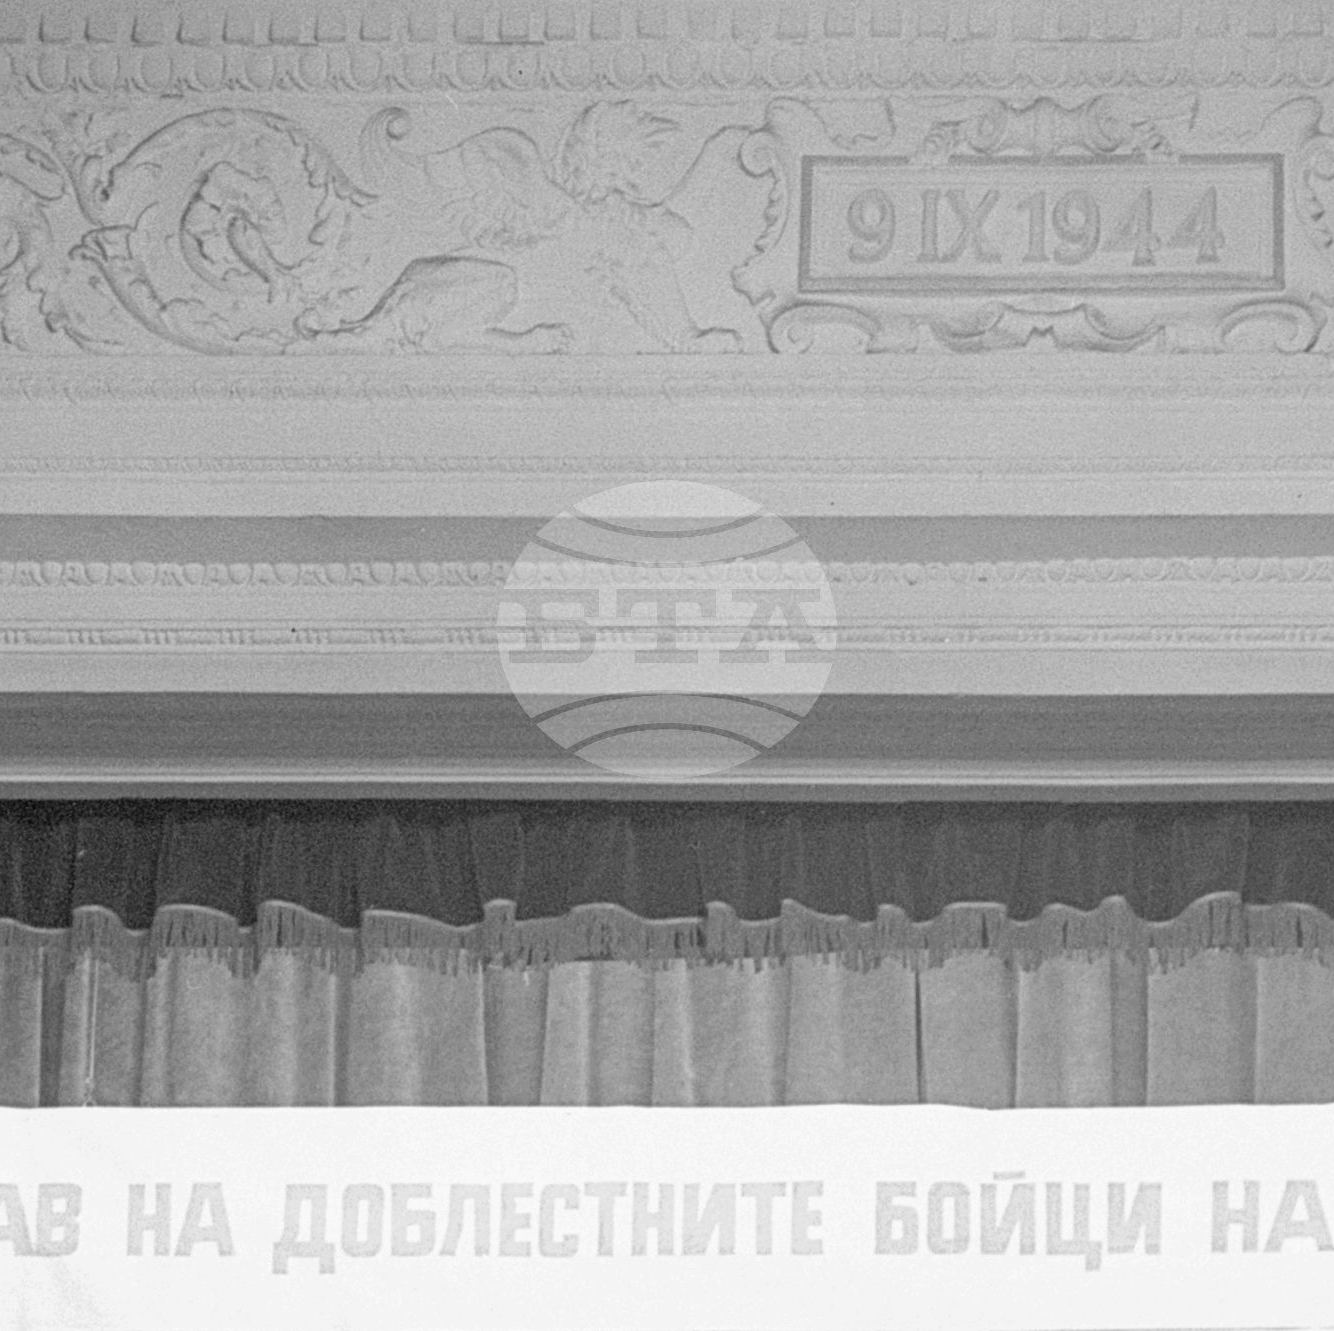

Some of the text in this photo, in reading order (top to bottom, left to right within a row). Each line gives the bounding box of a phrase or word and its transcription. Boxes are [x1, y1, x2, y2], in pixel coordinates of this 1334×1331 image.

[846, 186, 1225, 266] 9 IX 1944
[126, 1181, 237, 1257] НА
[272, 1180, 825, 1275] ДОБЛЕСТНИТЕ
[873, 1170, 1164, 1271] БОЙЦИ
